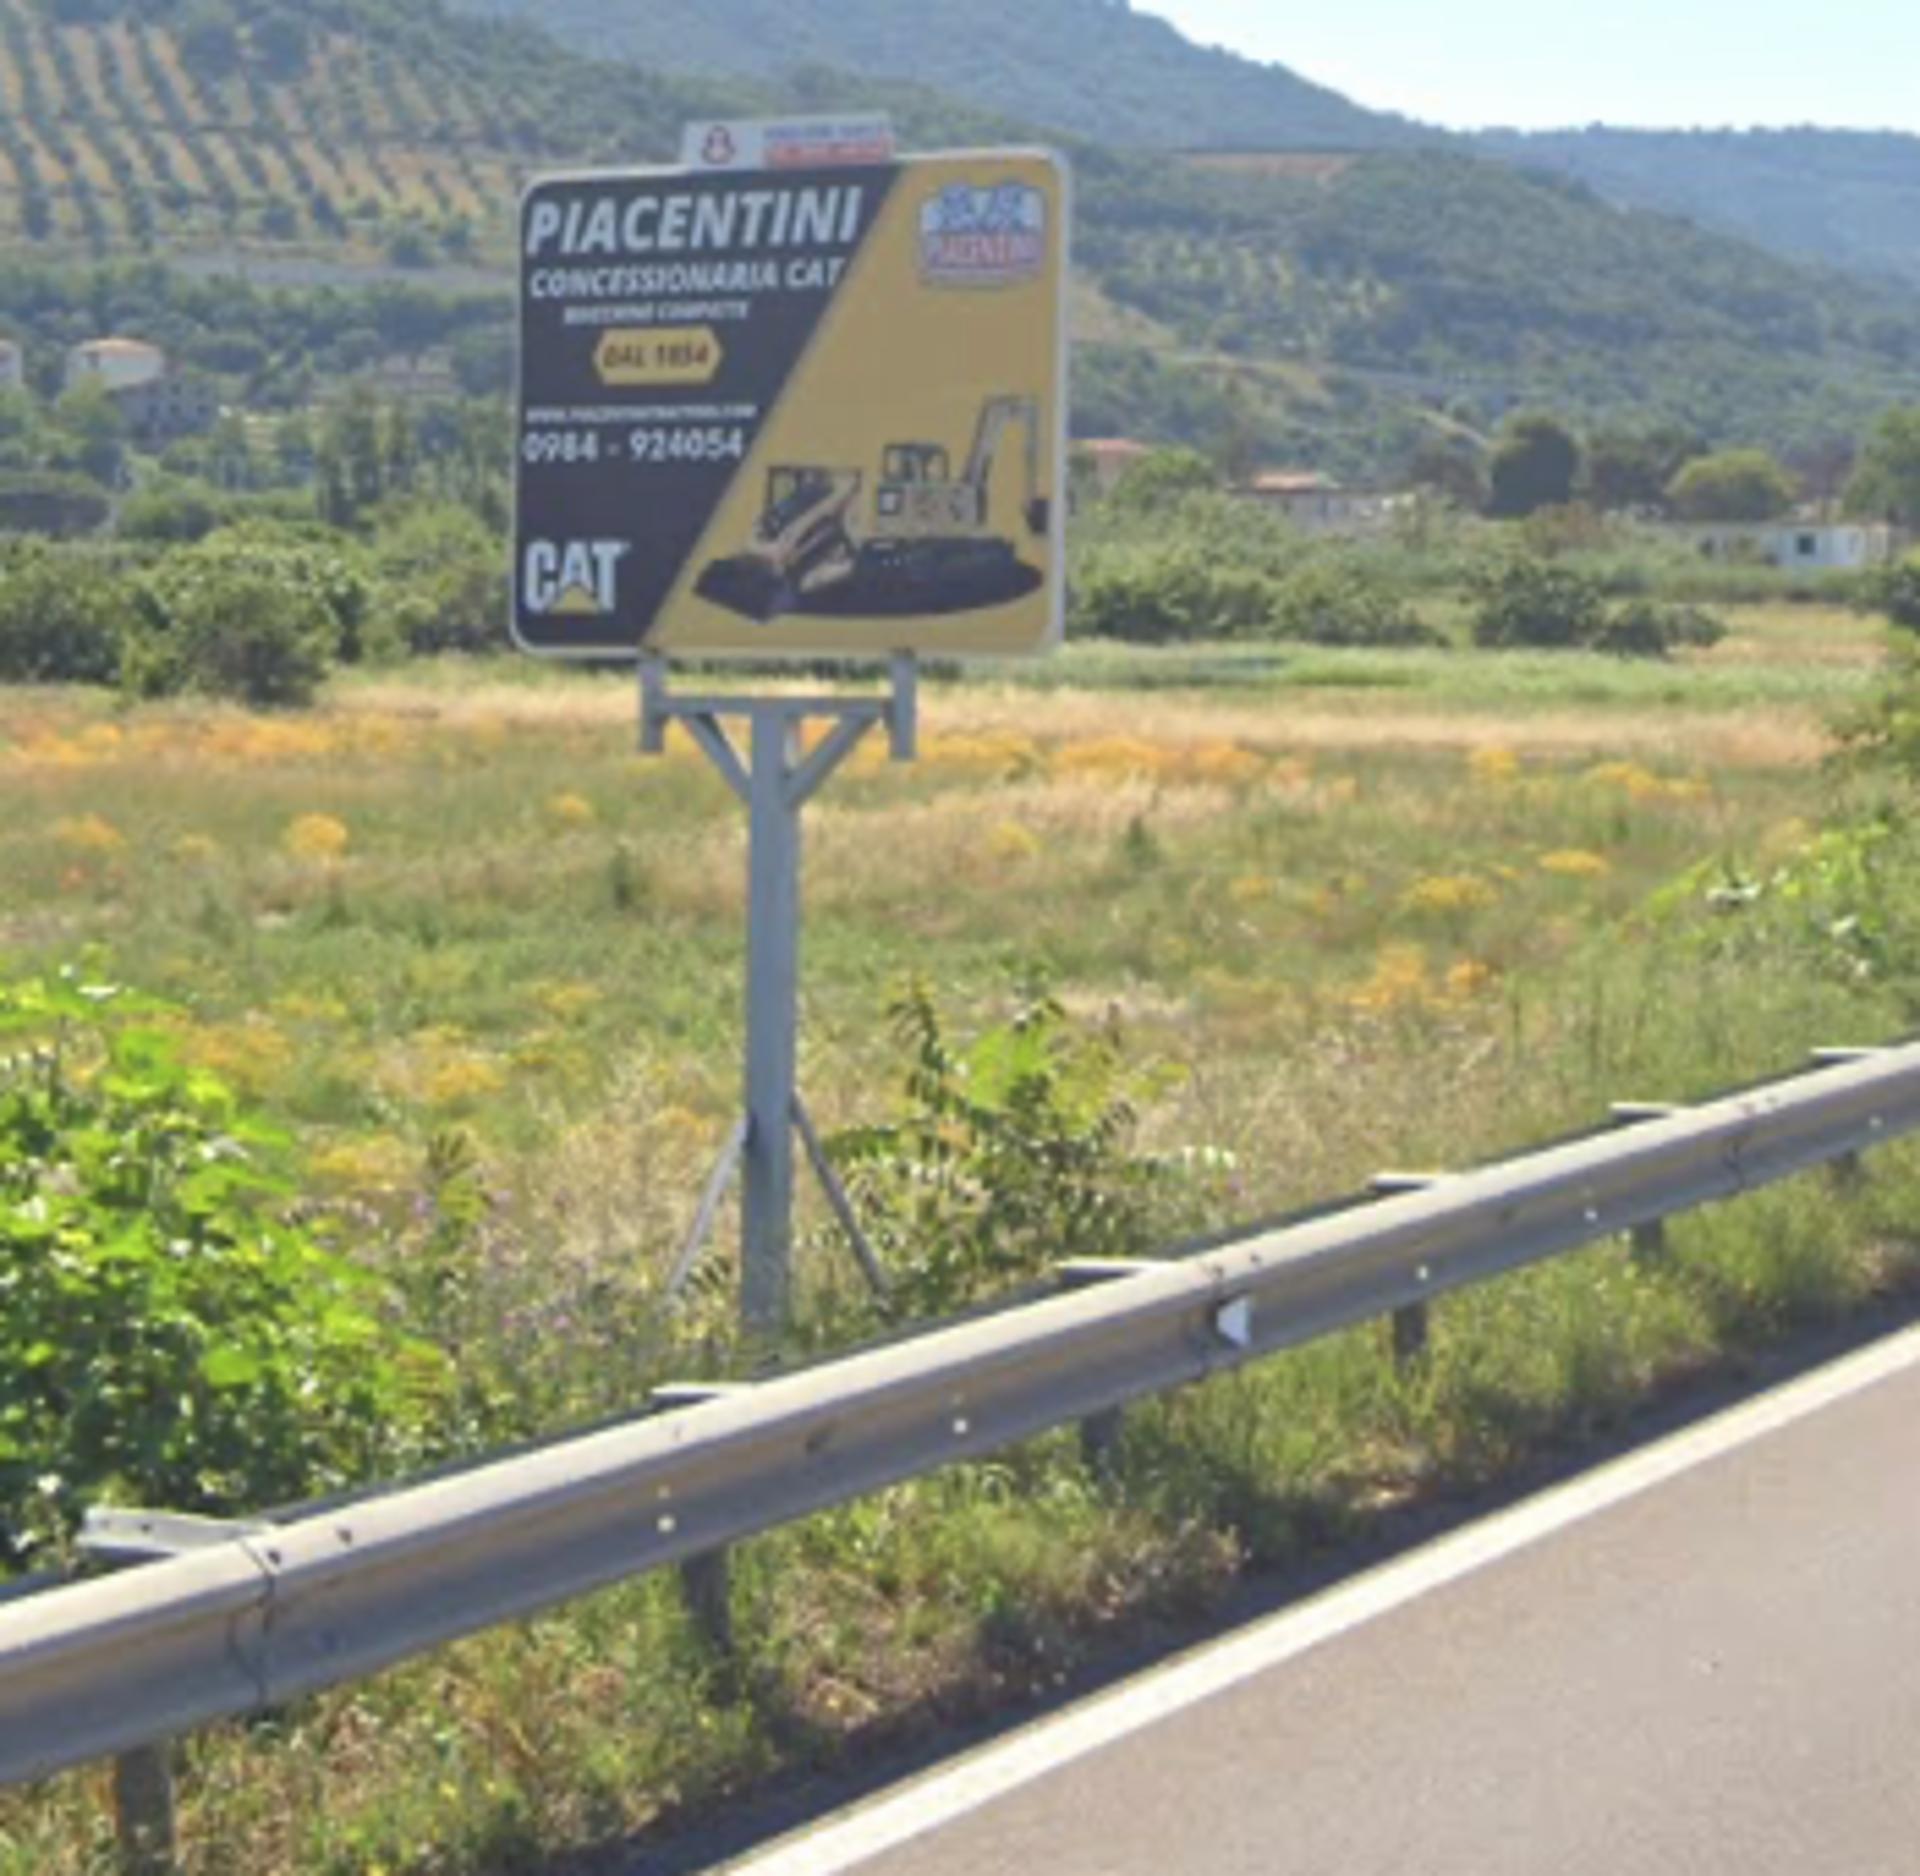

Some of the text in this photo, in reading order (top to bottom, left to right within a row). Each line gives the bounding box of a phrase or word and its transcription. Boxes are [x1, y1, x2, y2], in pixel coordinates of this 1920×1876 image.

[525, 185, 862, 255] PIACENTINI
[530, 257, 846, 298] CONCESSIONARIA CAT
[602, 344, 646, 370] DAL
[524, 430, 598, 463] 0984
[629, 427, 743, 462] 924054
[525, 538, 629, 613] CAT
